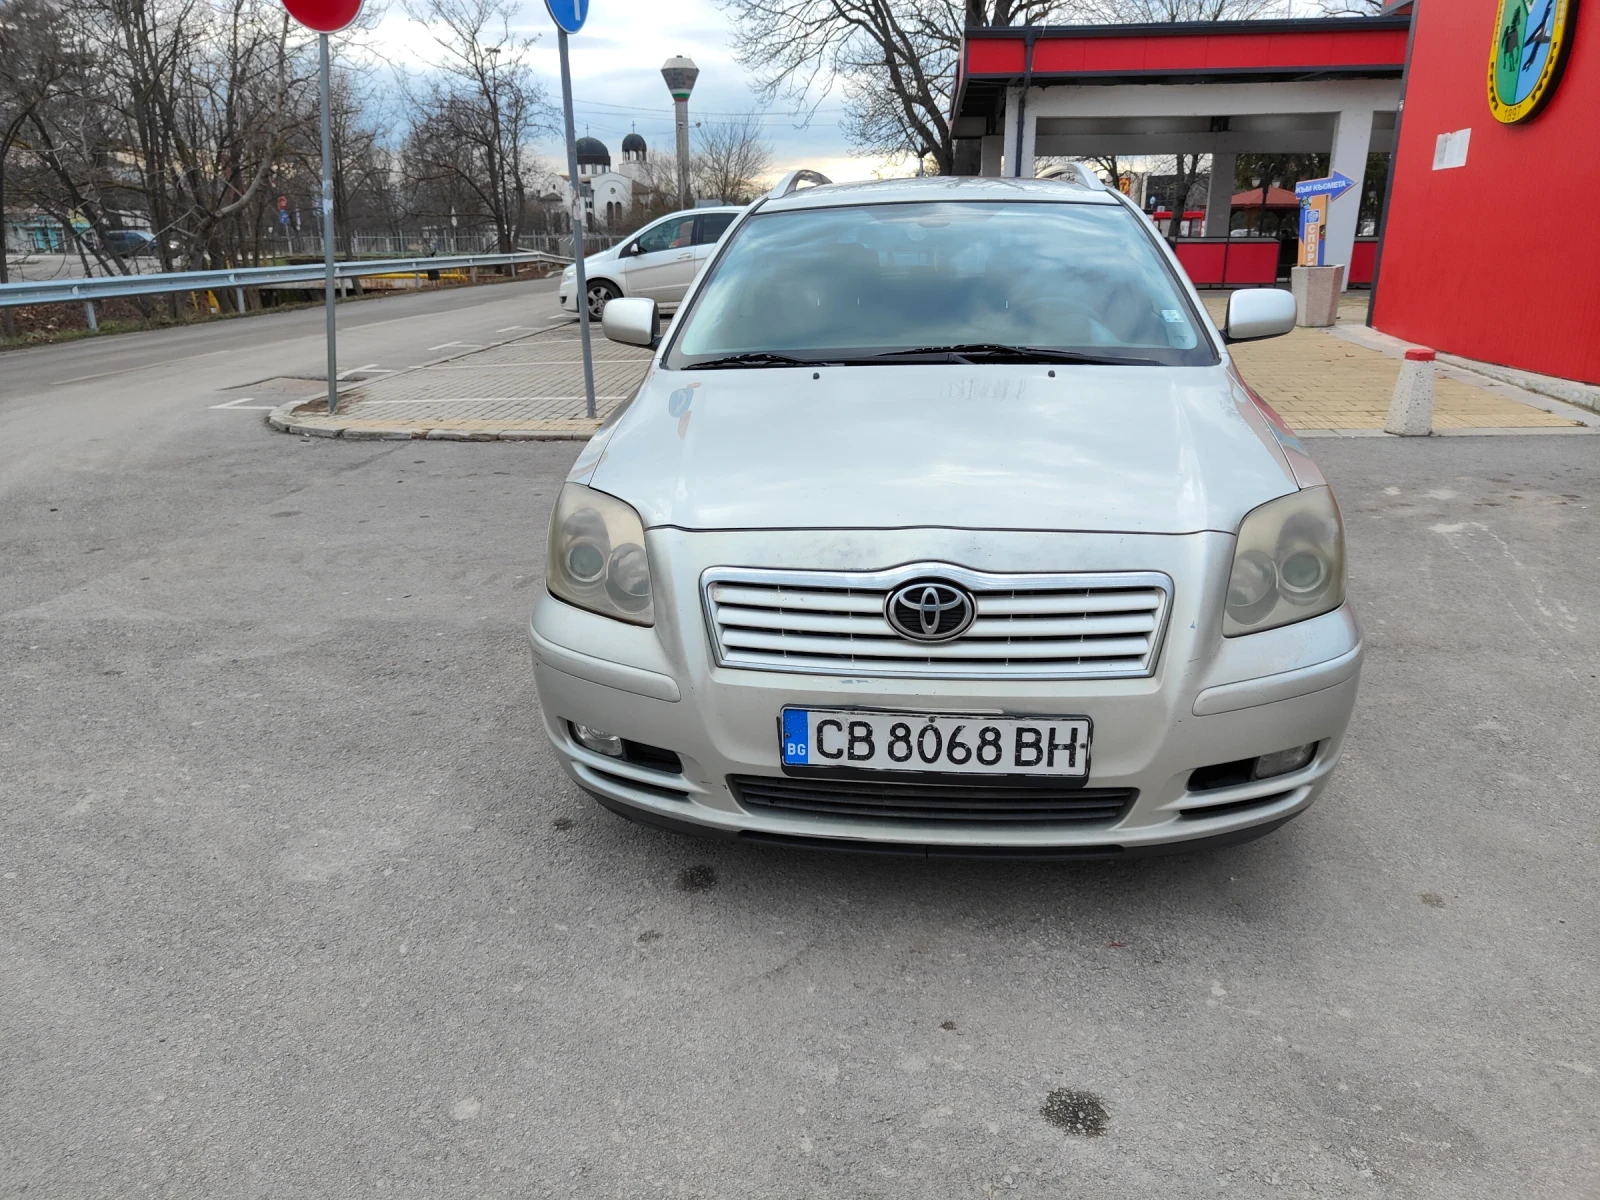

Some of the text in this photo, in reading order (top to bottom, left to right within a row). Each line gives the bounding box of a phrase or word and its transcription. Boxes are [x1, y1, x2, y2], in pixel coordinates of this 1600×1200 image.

[1503, 104, 1522, 122] 1897
[1295, 180, 1346, 194] КЪМ КЪСМЕТА
[787, 743, 806, 756] BG
[816, 719, 1078, 768] CB 8068 BH
